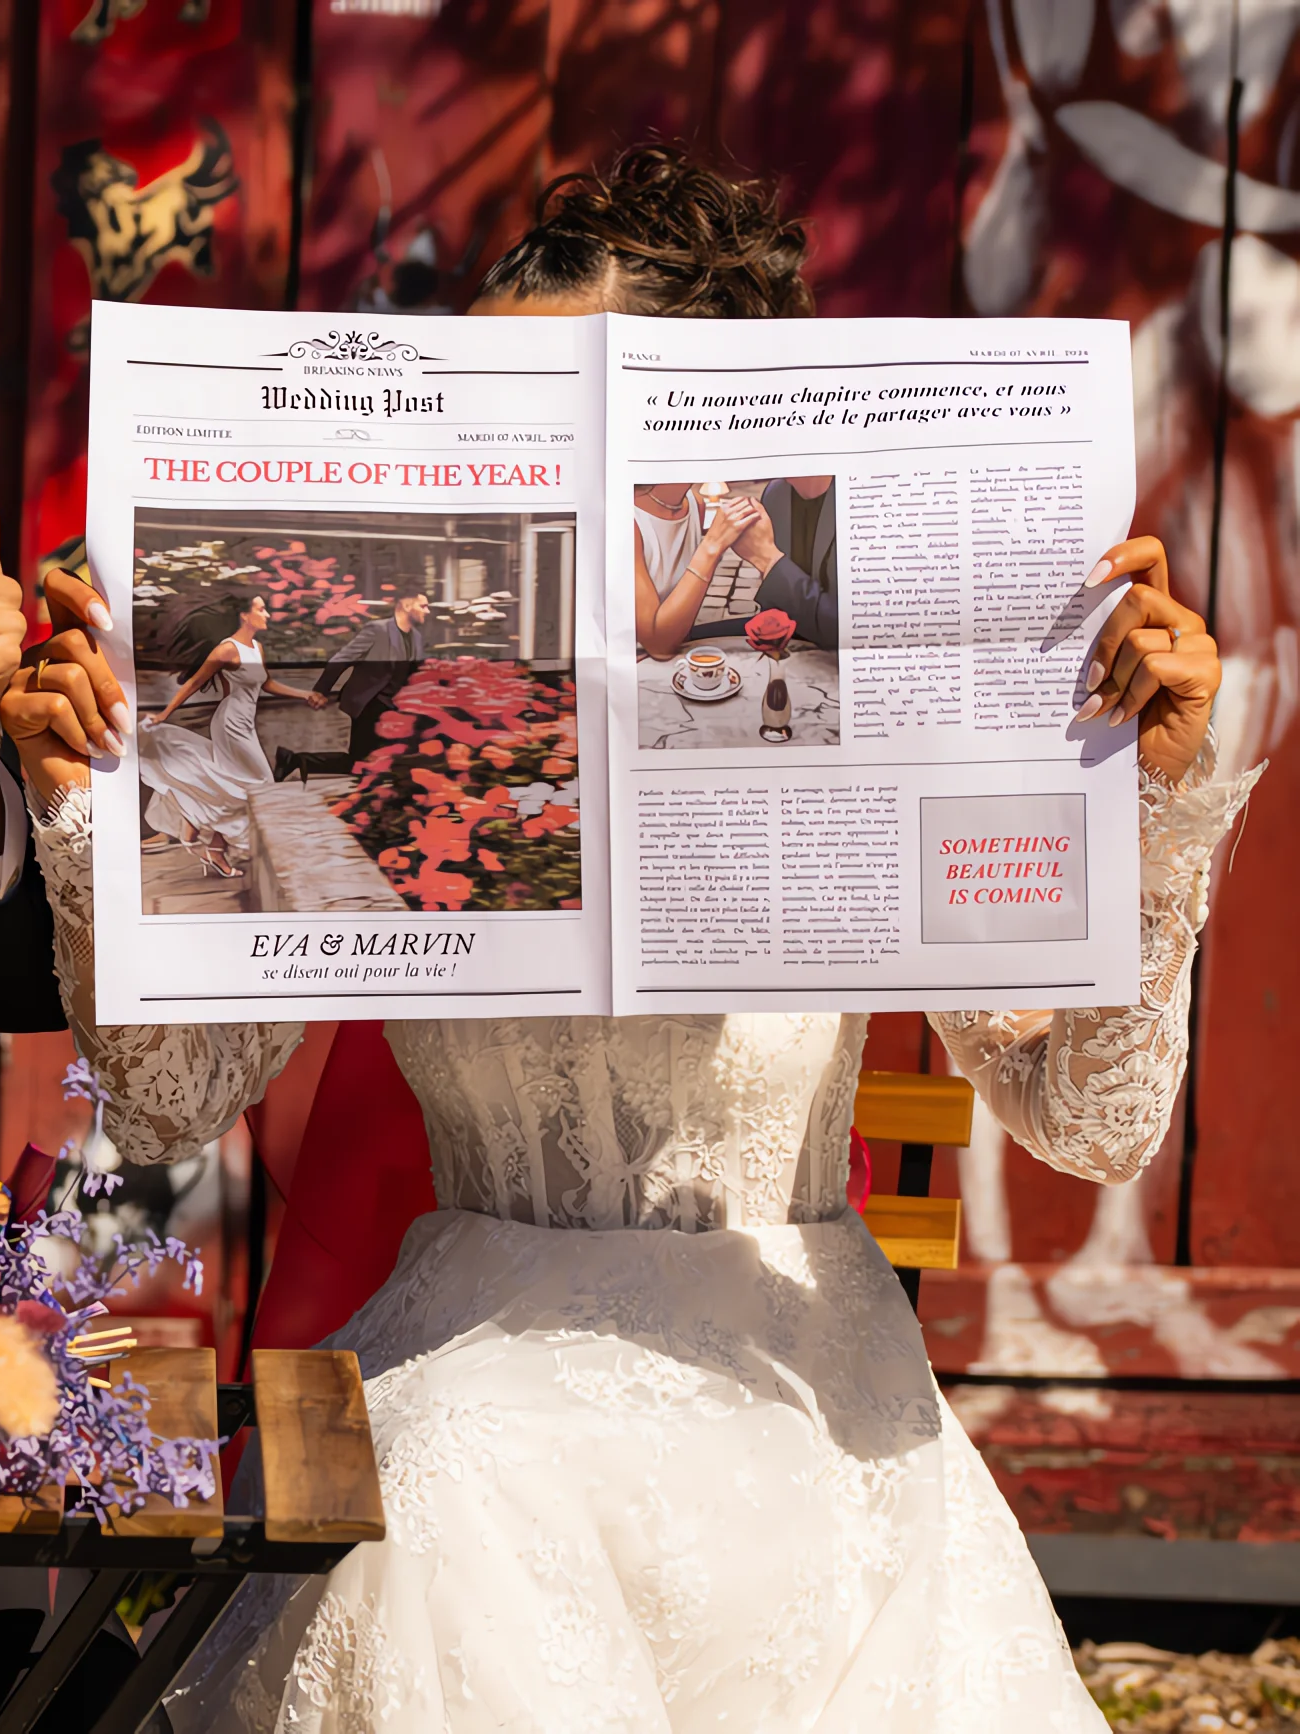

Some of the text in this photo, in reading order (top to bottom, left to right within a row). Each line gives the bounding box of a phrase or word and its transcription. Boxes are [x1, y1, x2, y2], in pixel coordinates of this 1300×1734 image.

[622, 351, 661, 362] FRANCE
[303, 365, 403, 377] BREAKING NEWS
[261, 385, 445, 418] Wedding Post
[667, 390, 695, 408] Un
[701, 393, 784, 408] nouveau
[790, 386, 872, 407] chapitre
[878, 385, 988, 400] commence,
[995, 384, 1015, 398] et
[1020, 384, 1067, 396] nous
[643, 418, 722, 431] sommes
[728, 410, 806, 431] honorés
[812, 409, 835, 425] de
[841, 409, 859, 425] le
[863, 407, 952, 429] partager
[957, 406, 1003, 419] avec
[1009, 405, 1053, 417] vous
[457, 433, 495, 442] MARDI
[144, 457, 211, 482] THE
[215, 460, 343, 483] COUPLE
[347, 462, 391, 485] OF
[395, 464, 462, 487] THE
[939, 836, 1070, 855] SOMETHING
[946, 862, 1063, 880] BEAUTIFUL
[949, 887, 1063, 905] IS COMING
[250, 932, 476, 957] EVA & MARVIN
[262, 968, 279, 980] se
[283, 964, 330, 979] disent
[334, 964, 360, 978] oui
[363, 967, 400, 982] pour
[405, 962, 419, 977] la
[425, 964, 447, 977] vie
